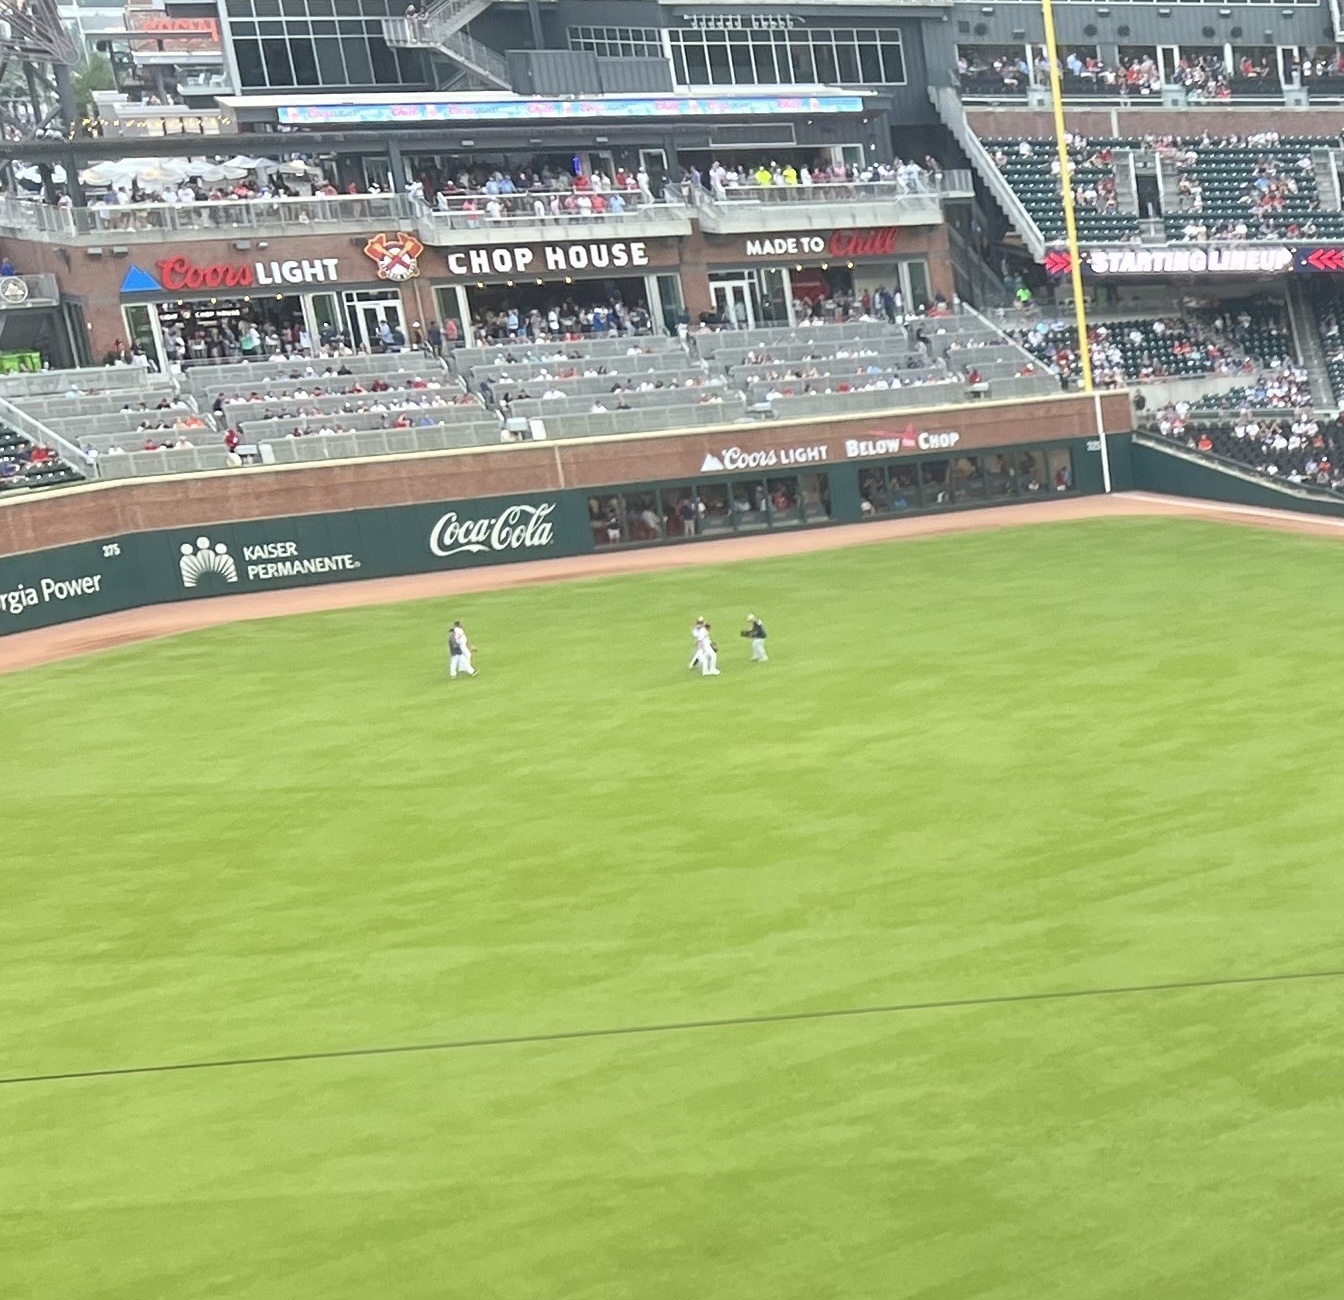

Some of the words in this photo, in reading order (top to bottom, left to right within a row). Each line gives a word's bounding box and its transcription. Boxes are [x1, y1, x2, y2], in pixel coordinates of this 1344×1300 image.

[746, 237, 798, 256] MADE
[799, 236, 824, 253] TO
[828, 228, 897, 257] Chill
[447, 246, 533, 274] CHOP
[546, 242, 649, 270] HOUSE
[1090, 249, 1206, 273] STARTING
[1208, 248, 1292, 272] LINEUP
[158, 255, 251, 289] Coors
[255, 258, 338, 284] LIGHT
[721, 447, 778, 470] Coors
[780, 446, 828, 464] LIGHT
[845, 439, 899, 458] BELOW
[918, 433, 960, 450] CHOP
[243, 541, 297, 561] KAISER
[247, 554, 354, 580] PERMANENTE
[0, 587, 38, 614] rgia
[41, 573, 102, 601] Power
